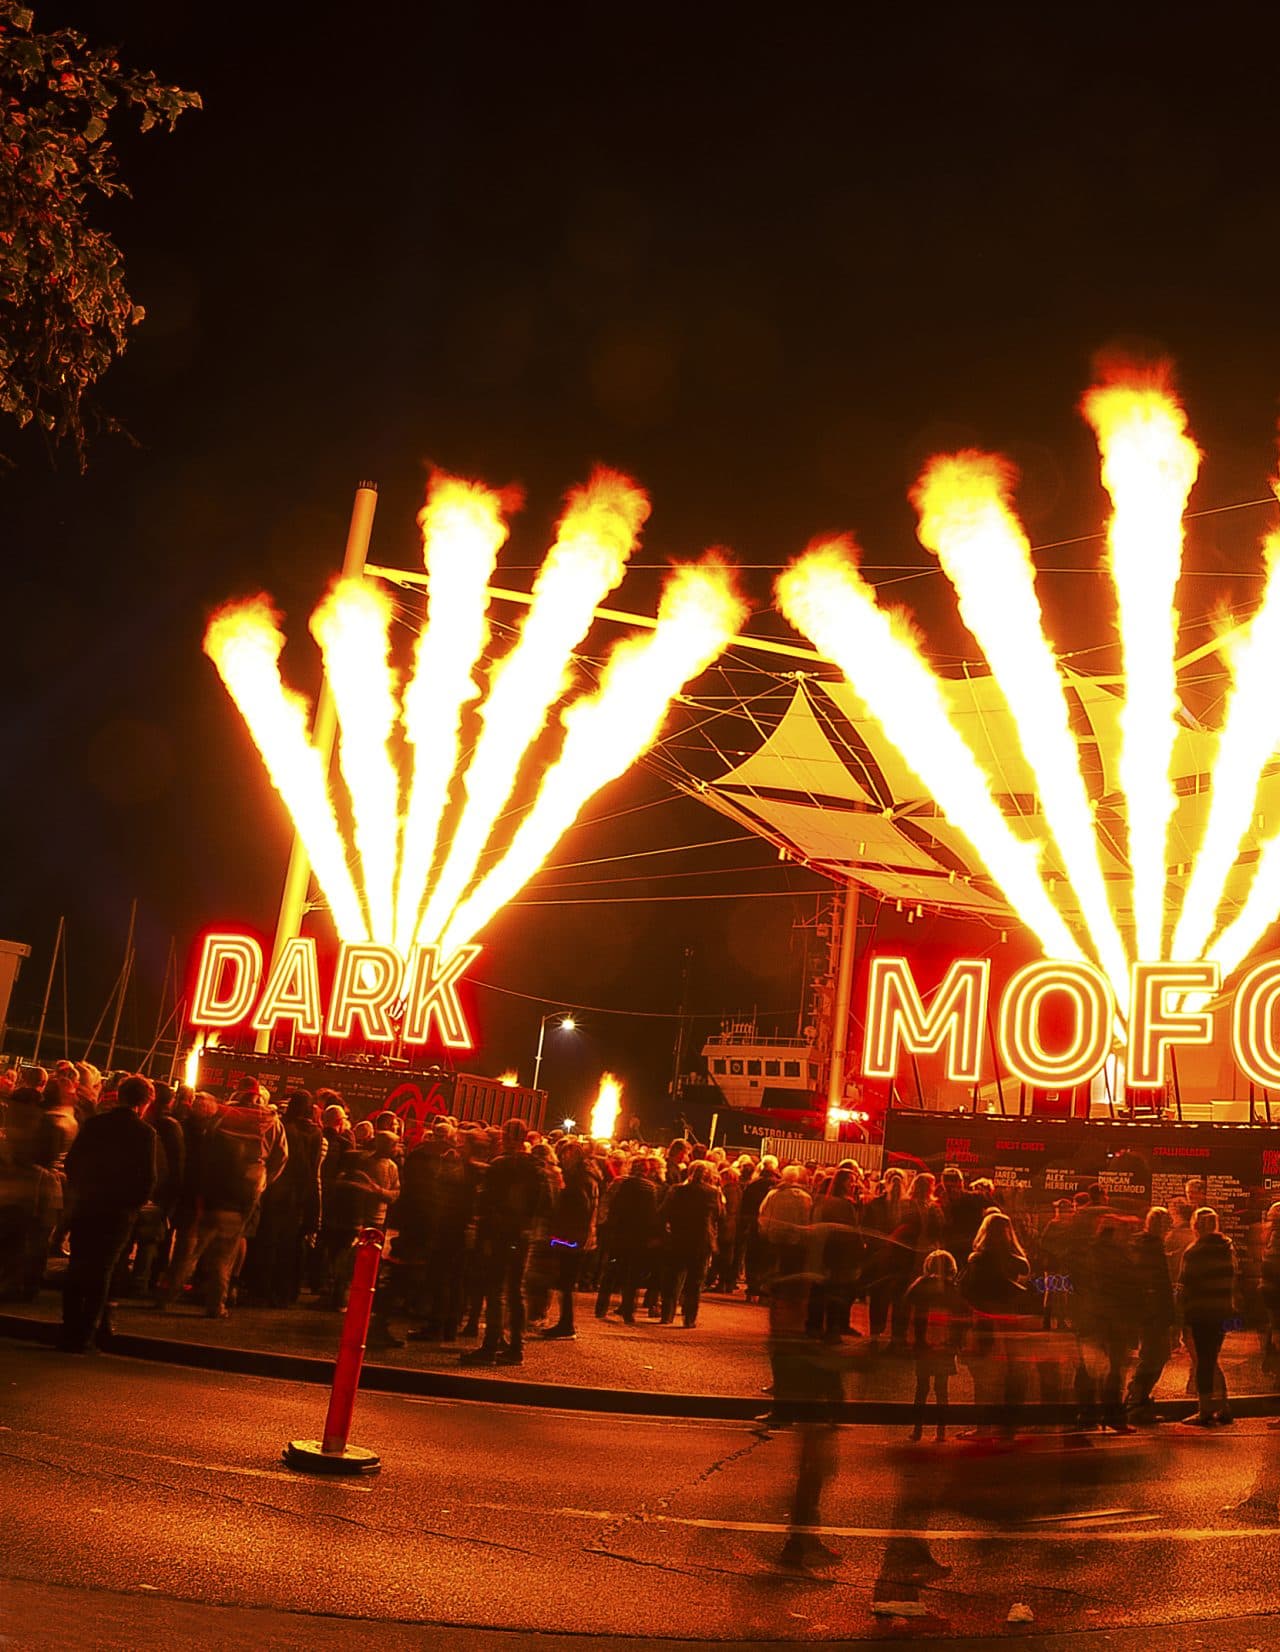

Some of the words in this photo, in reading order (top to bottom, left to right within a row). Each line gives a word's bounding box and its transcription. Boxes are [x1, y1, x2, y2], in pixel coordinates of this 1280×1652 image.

[190, 933, 483, 1049] DARK
[995, 1172, 1017, 1181] JARED
[1098, 1176, 1130, 1185] DUNCAN
[1045, 1182, 1079, 1192] HERBERT
